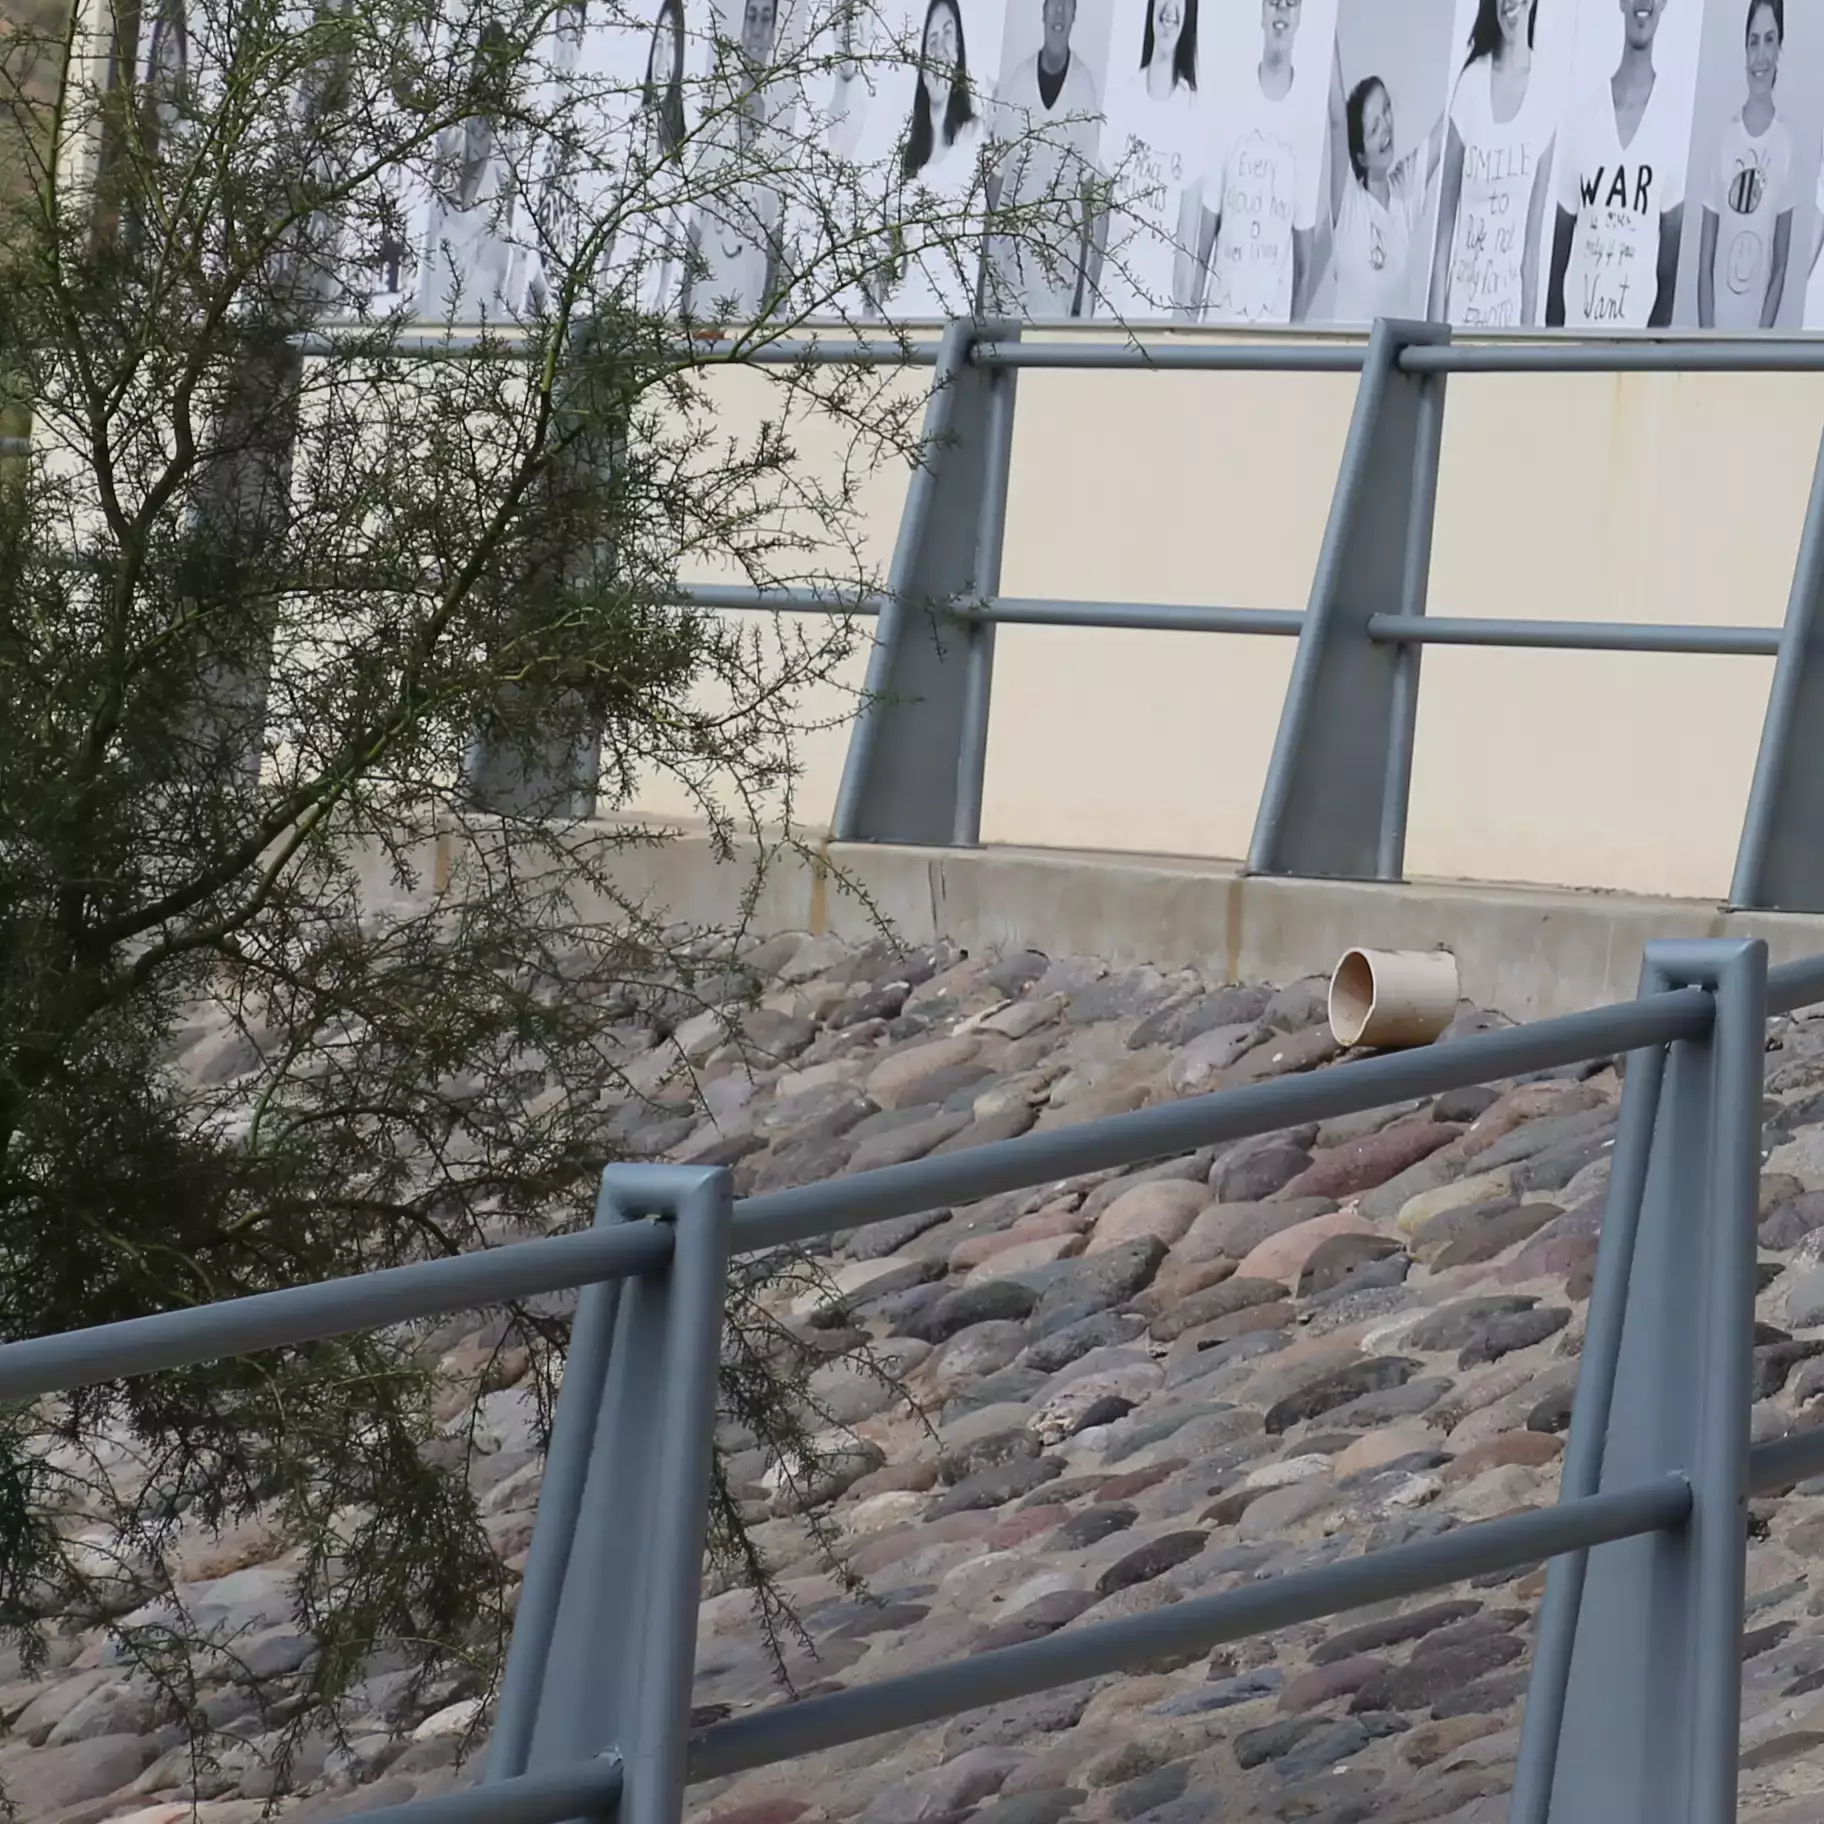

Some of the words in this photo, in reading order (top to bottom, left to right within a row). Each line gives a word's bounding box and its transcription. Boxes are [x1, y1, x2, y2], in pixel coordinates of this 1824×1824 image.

[1465, 142, 1531, 184] SMILE
[1488, 189, 1509, 215] to
[1580, 164, 1654, 215] WAR
